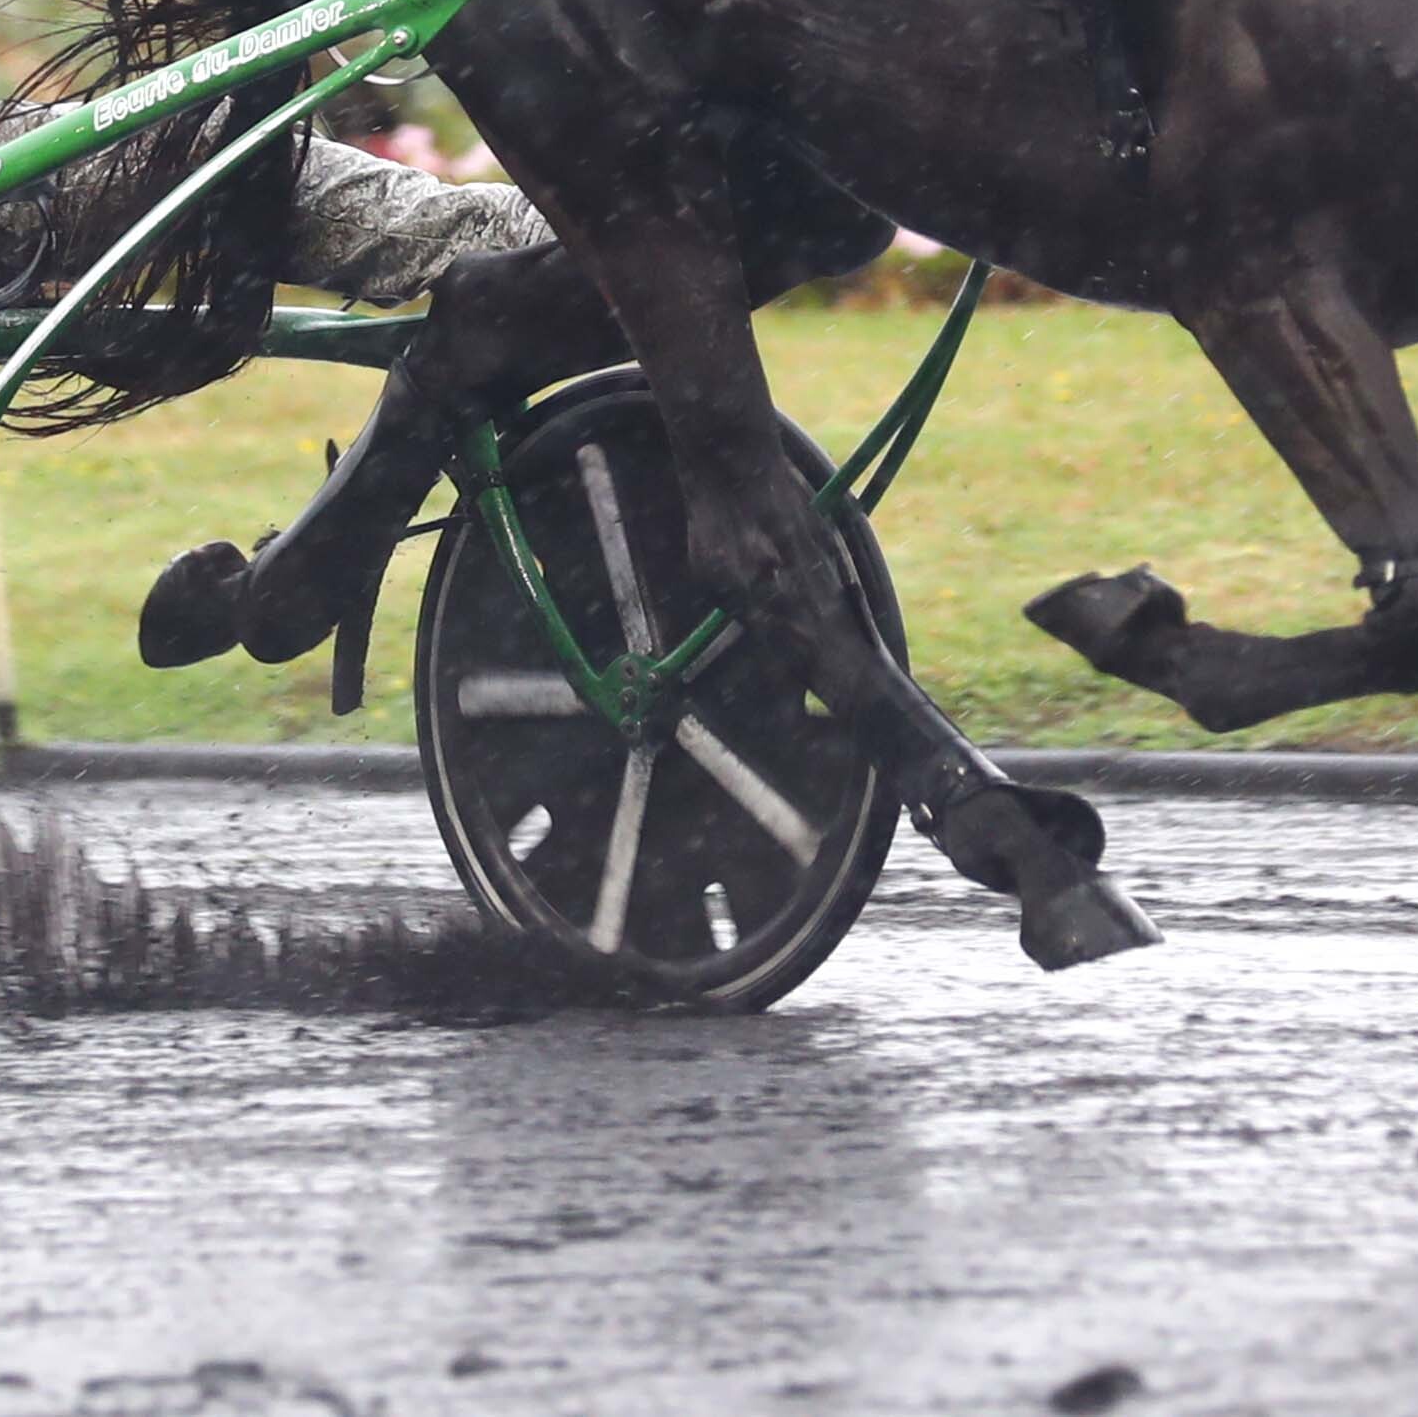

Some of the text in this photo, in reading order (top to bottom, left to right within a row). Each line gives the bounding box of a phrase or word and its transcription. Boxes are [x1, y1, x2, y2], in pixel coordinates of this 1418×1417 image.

[94, 0, 345, 131] Ecurie du Damier
